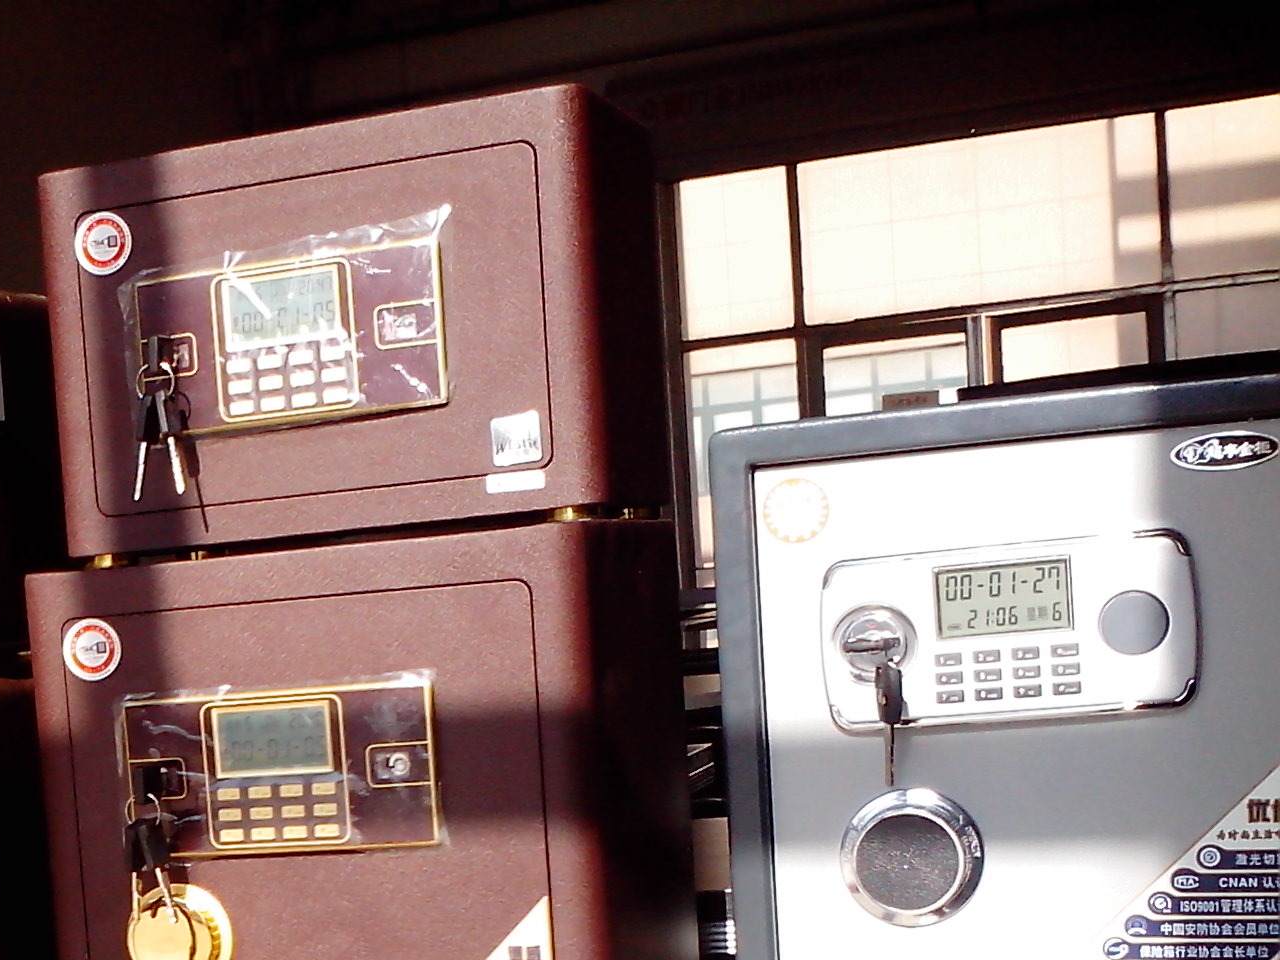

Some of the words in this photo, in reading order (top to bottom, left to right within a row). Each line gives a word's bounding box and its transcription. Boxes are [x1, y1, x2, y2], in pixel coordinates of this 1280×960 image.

[945, 566, 1060, 602] 00-01-27
[967, 606, 1018, 629] 21:06
[1218, 877, 1258, 888] CNAN
